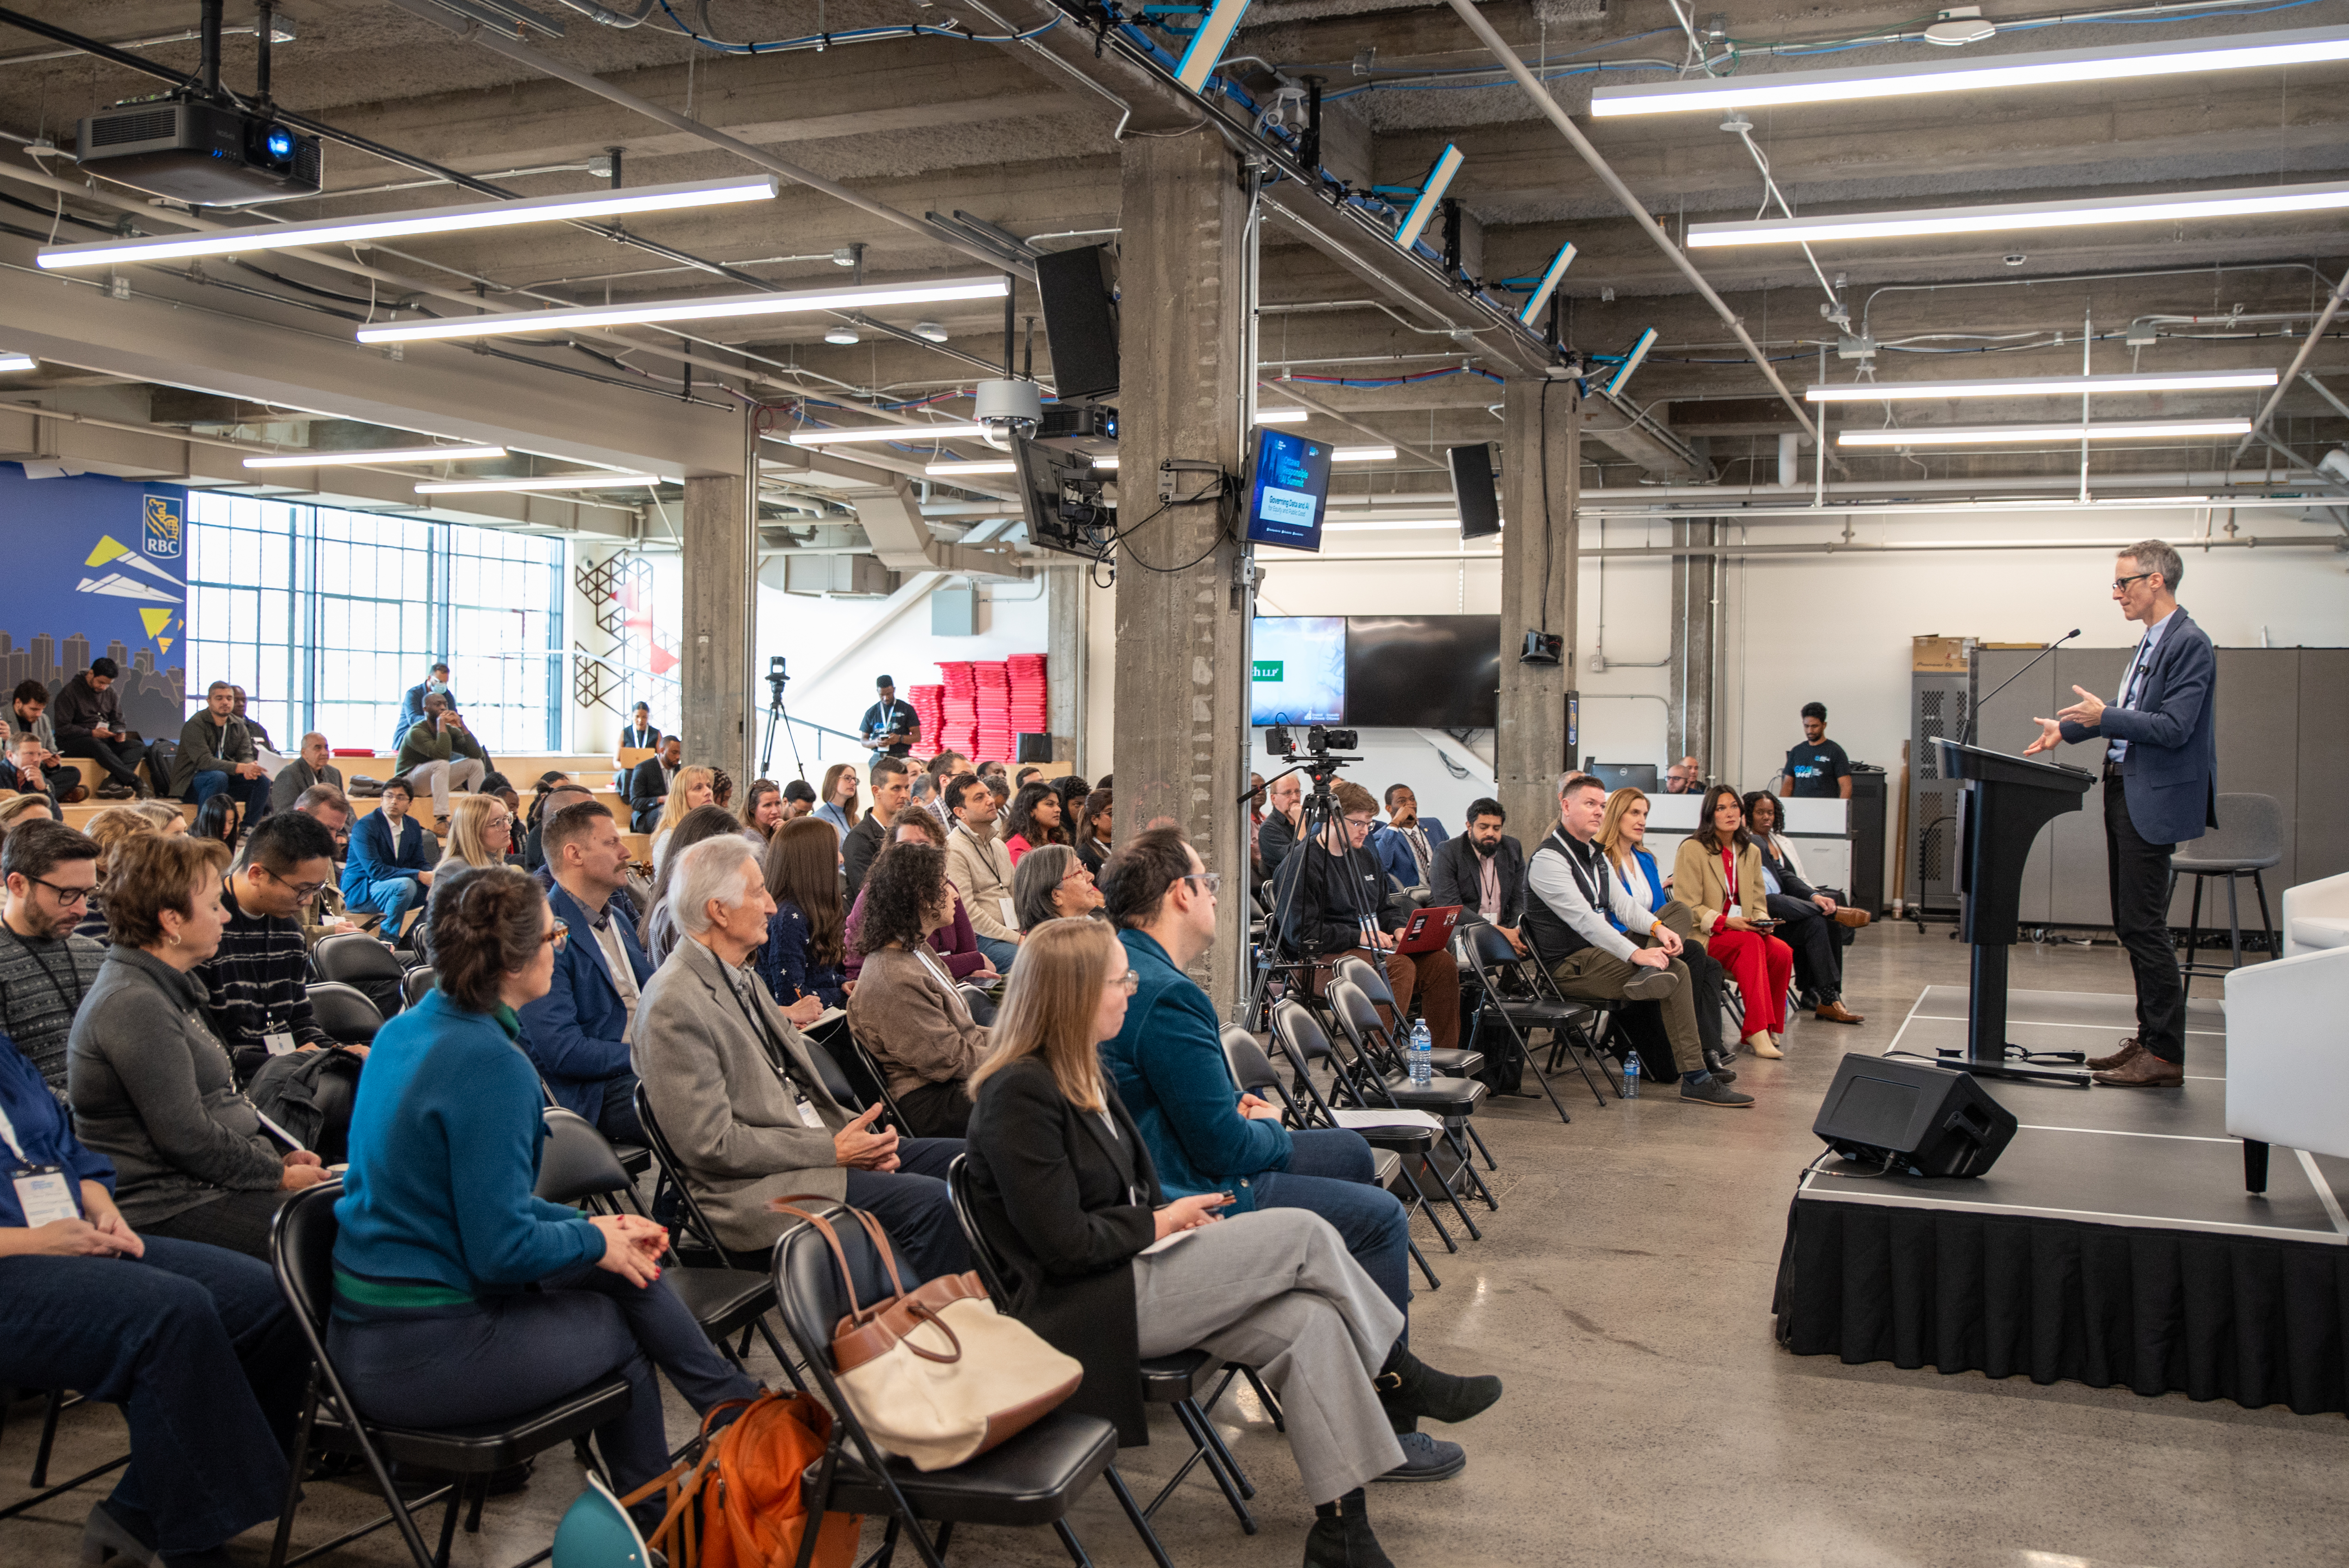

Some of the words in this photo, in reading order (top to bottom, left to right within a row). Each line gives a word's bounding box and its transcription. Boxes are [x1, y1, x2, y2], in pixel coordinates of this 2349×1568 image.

[1284, 456, 1300, 468] Ottawa
[1283, 465, 1309, 479] Responsible
[1286, 475, 1304, 488] Summit
[1269, 495, 1289, 508] Governing
[1289, 499, 1298, 508] Data
[1273, 506, 1282, 514] Equity
[148, 538, 177, 554] RBC
